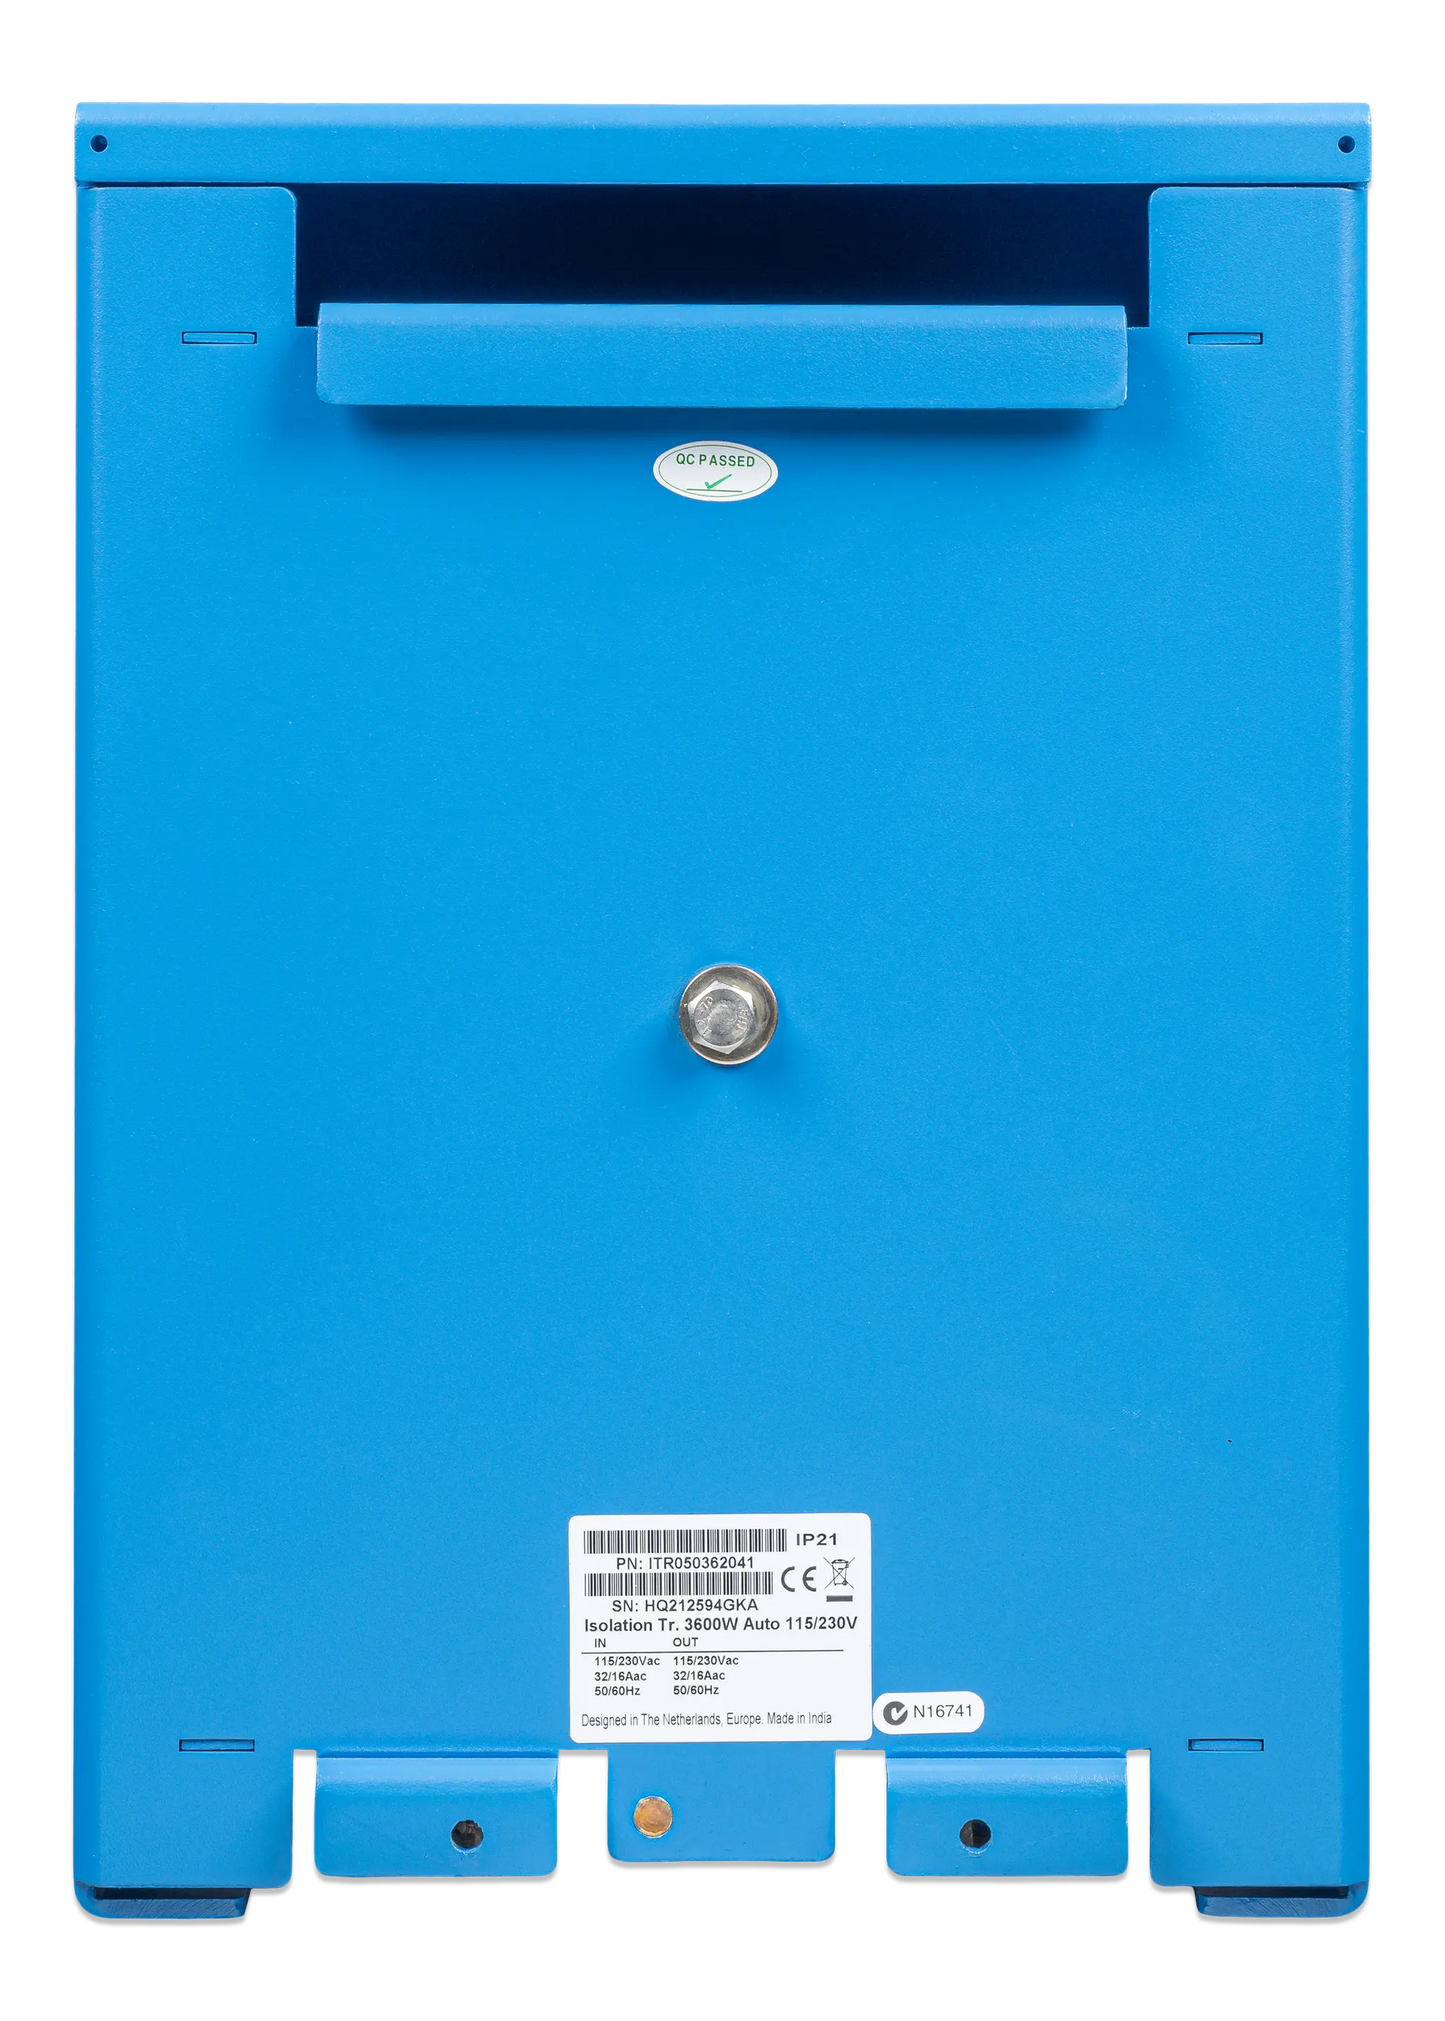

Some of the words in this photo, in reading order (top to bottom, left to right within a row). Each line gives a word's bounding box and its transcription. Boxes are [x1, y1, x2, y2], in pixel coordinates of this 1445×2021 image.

[676, 453, 695, 465] QC
[699, 454, 755, 467] PASSED
[797, 1533, 836, 1545] IP21
[617, 1557, 642, 1570] PN:
[650, 1556, 752, 1569] ITR050362041
[781, 1566, 816, 1592] CE
[613, 1600, 638, 1612] SN:
[645, 1599, 758, 1613] HQ212594GKA
[585, 1618, 652, 1631] Isolation
[658, 1618, 678, 1631] Tr.
[685, 1618, 738, 1630] 3600W
[743, 1617, 780, 1630] Auto
[786, 1616, 857, 1629] 115/230V
[595, 1638, 606, 1647] IN
[673, 1637, 698, 1647] OUT
[595, 1656, 660, 1665] 115/230Vac
[674, 1656, 738, 1665] 115/230Vac
[595, 1672, 646, 1681] 32/16Aac
[674, 1671, 725, 1680] 32/16Aac
[595, 1686, 640, 1695] 50/60Hz
[674, 1685, 719, 1695] 50/60Hz
[914, 1705, 971, 1718] N16741
[582, 1714, 626, 1729] Designed
[631, 1714, 638, 1725] in
[641, 1714, 659, 1725] The
[663, 1713, 723, 1728] Netherlands,
[727, 1712, 763, 1728] Europe.
[768, 1712, 793, 1724] Made
[798, 1712, 805, 1723] in
[809, 1712, 831, 1723] India
